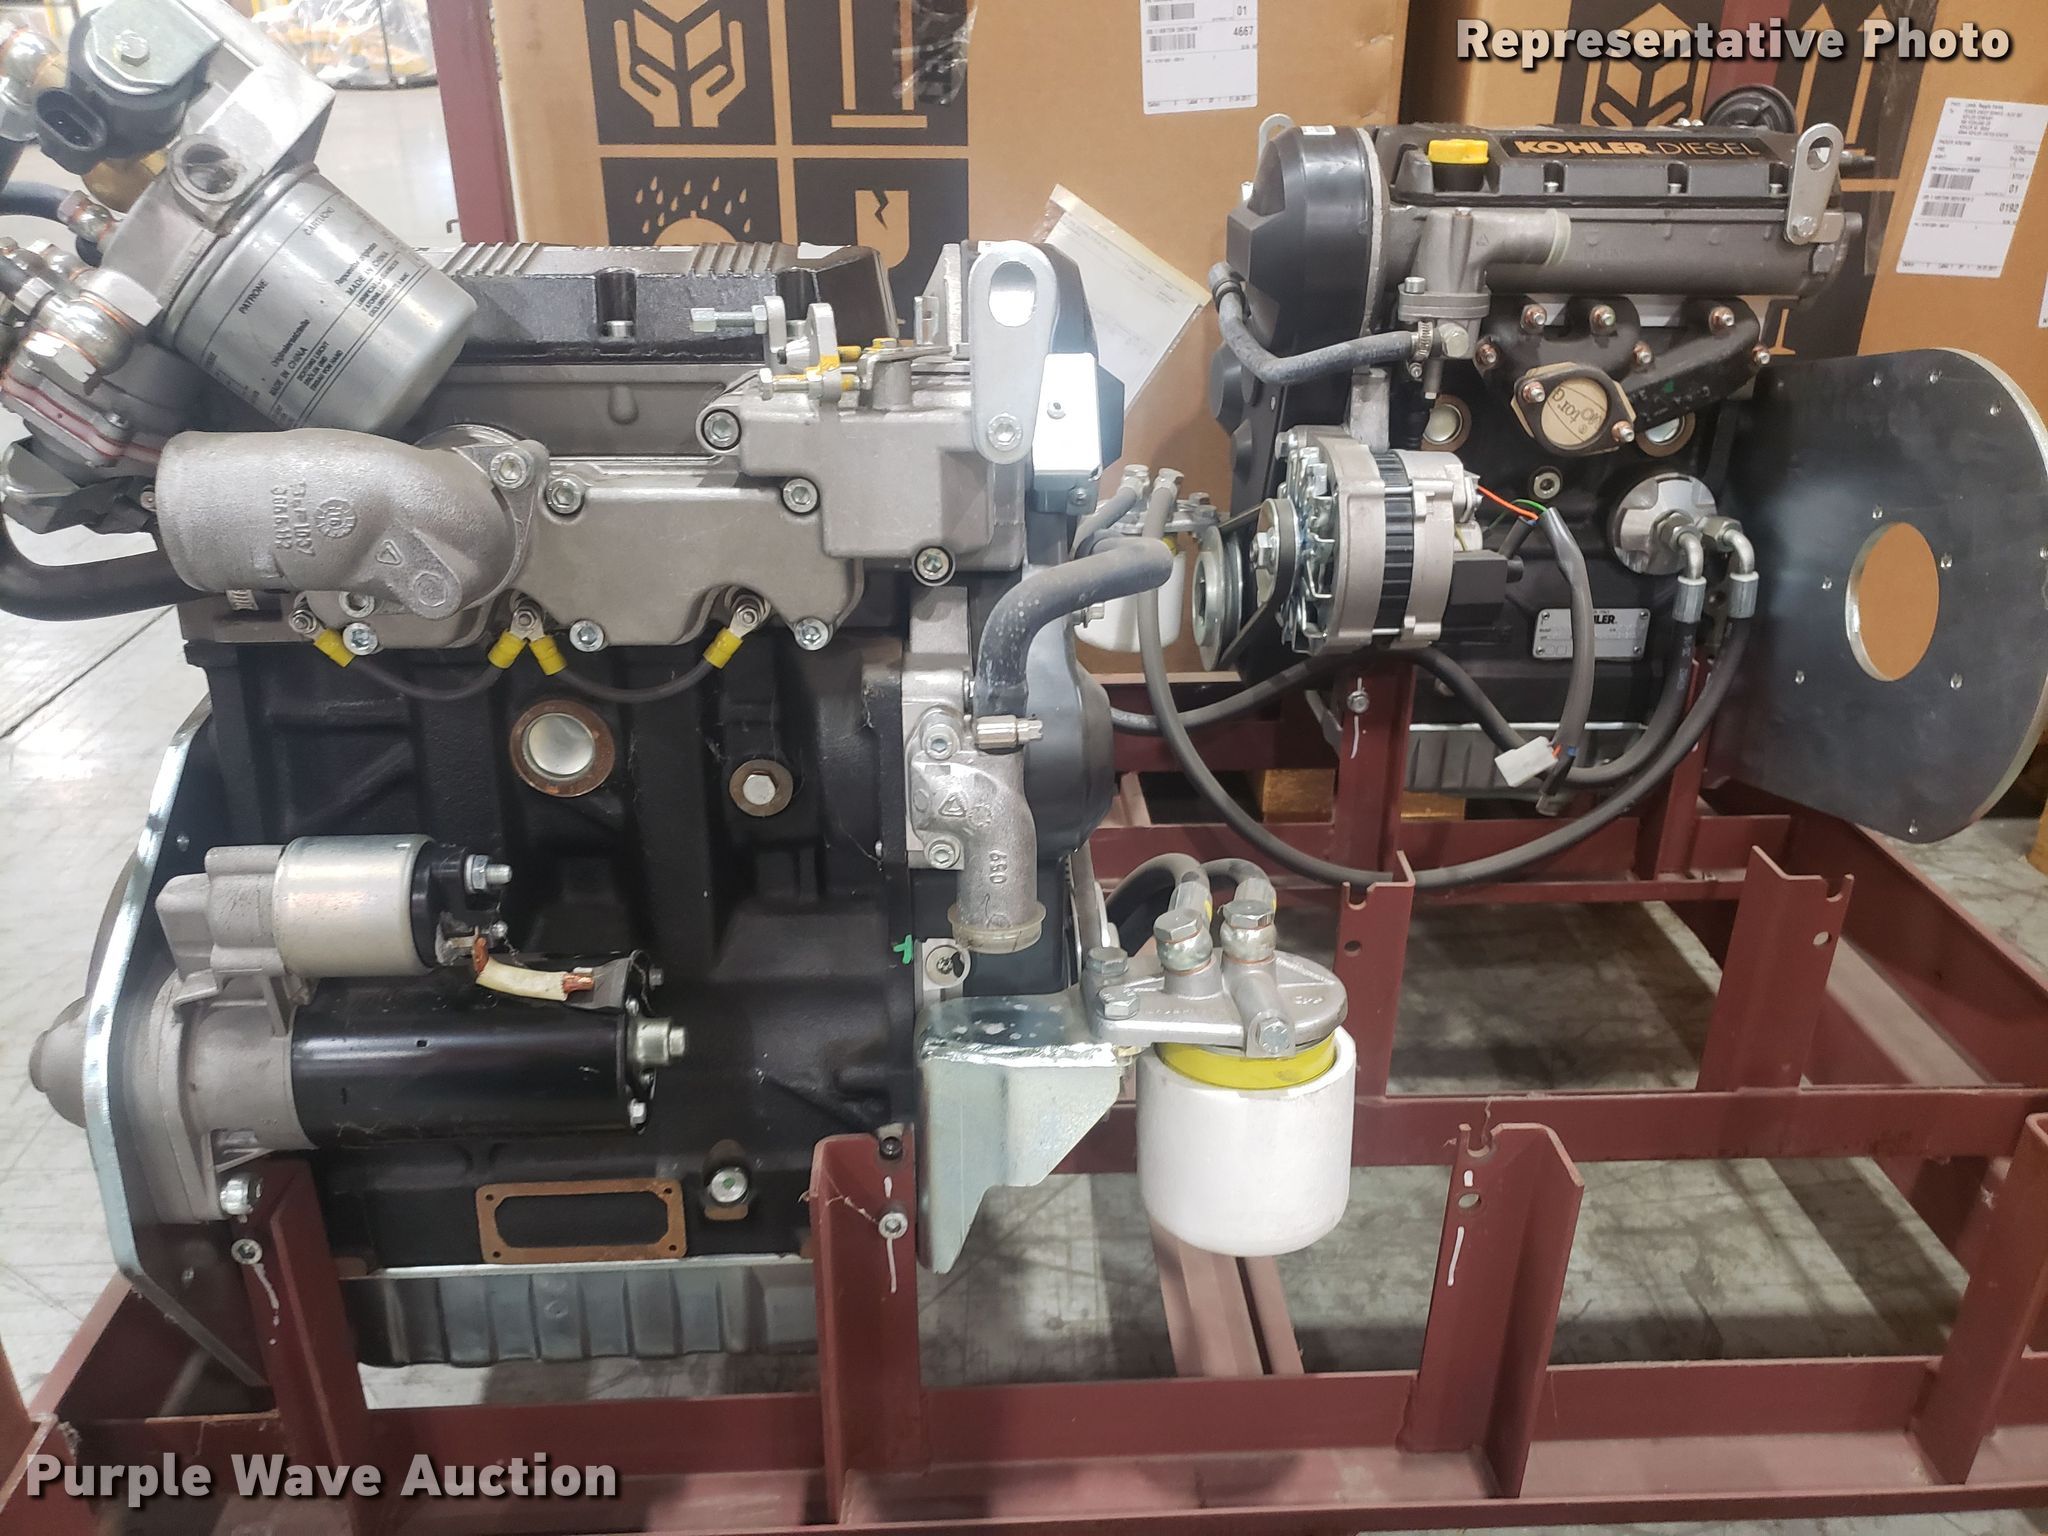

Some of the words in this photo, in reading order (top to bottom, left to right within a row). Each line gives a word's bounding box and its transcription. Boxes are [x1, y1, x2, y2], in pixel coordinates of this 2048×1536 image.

[1513, 140, 1653, 155] KOHLER
[1656, 141, 1761, 156] DIESEL
[239, 279, 268, 314] PATRONE
[345, 275, 367, 296] MADE
[287, 346, 309, 370] CHINA
